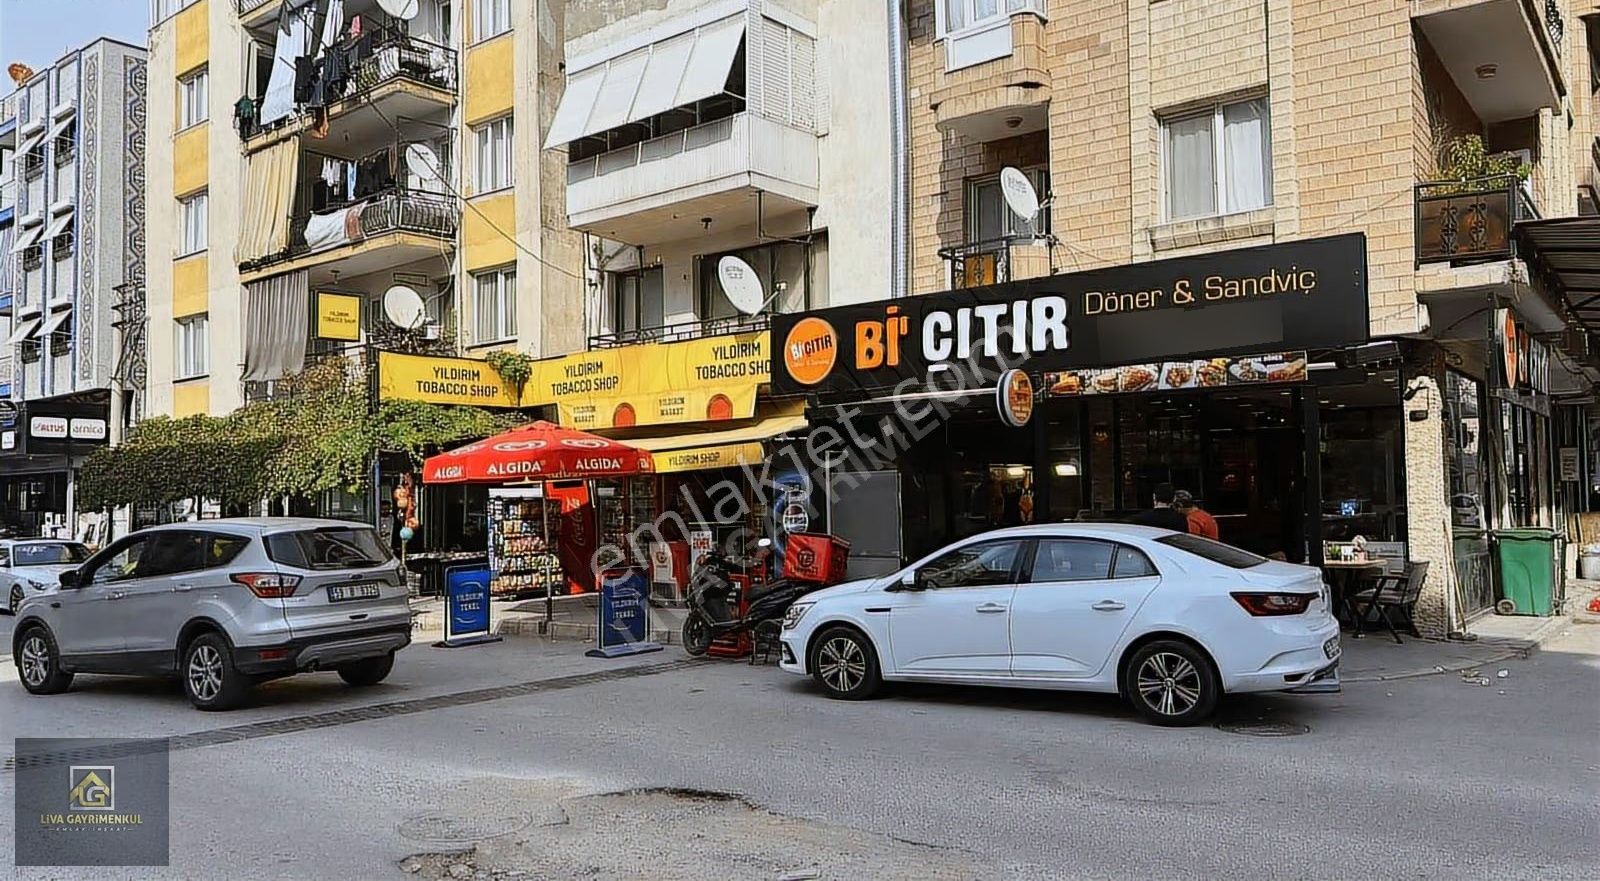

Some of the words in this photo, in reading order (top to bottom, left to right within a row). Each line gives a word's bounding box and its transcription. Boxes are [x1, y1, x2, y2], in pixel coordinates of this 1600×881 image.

[1085, 289, 1163, 315] Döner
[1172, 280, 1195, 304] &
[1205, 265, 1316, 300] Sandviç
[923, 296, 1068, 372] ÇITIR
[712, 341, 761, 360] YILDIRIM
[433, 367, 480, 381] YILDIRIM
[564, 361, 603, 378] YILDIRIM
[695, 362, 746, 380] TOBACCO
[749, 360, 771, 376] SHO
[416, 380, 467, 396] TOBACCO
[470, 384, 498, 398] SHOP
[551, 379, 592, 396] TOBACCO
[593, 375, 619, 391] SHOP
[72, 424, 103, 434] arnica
[700, 452, 720, 463] SHOP
[487, 461, 541, 475] ALGIDA
